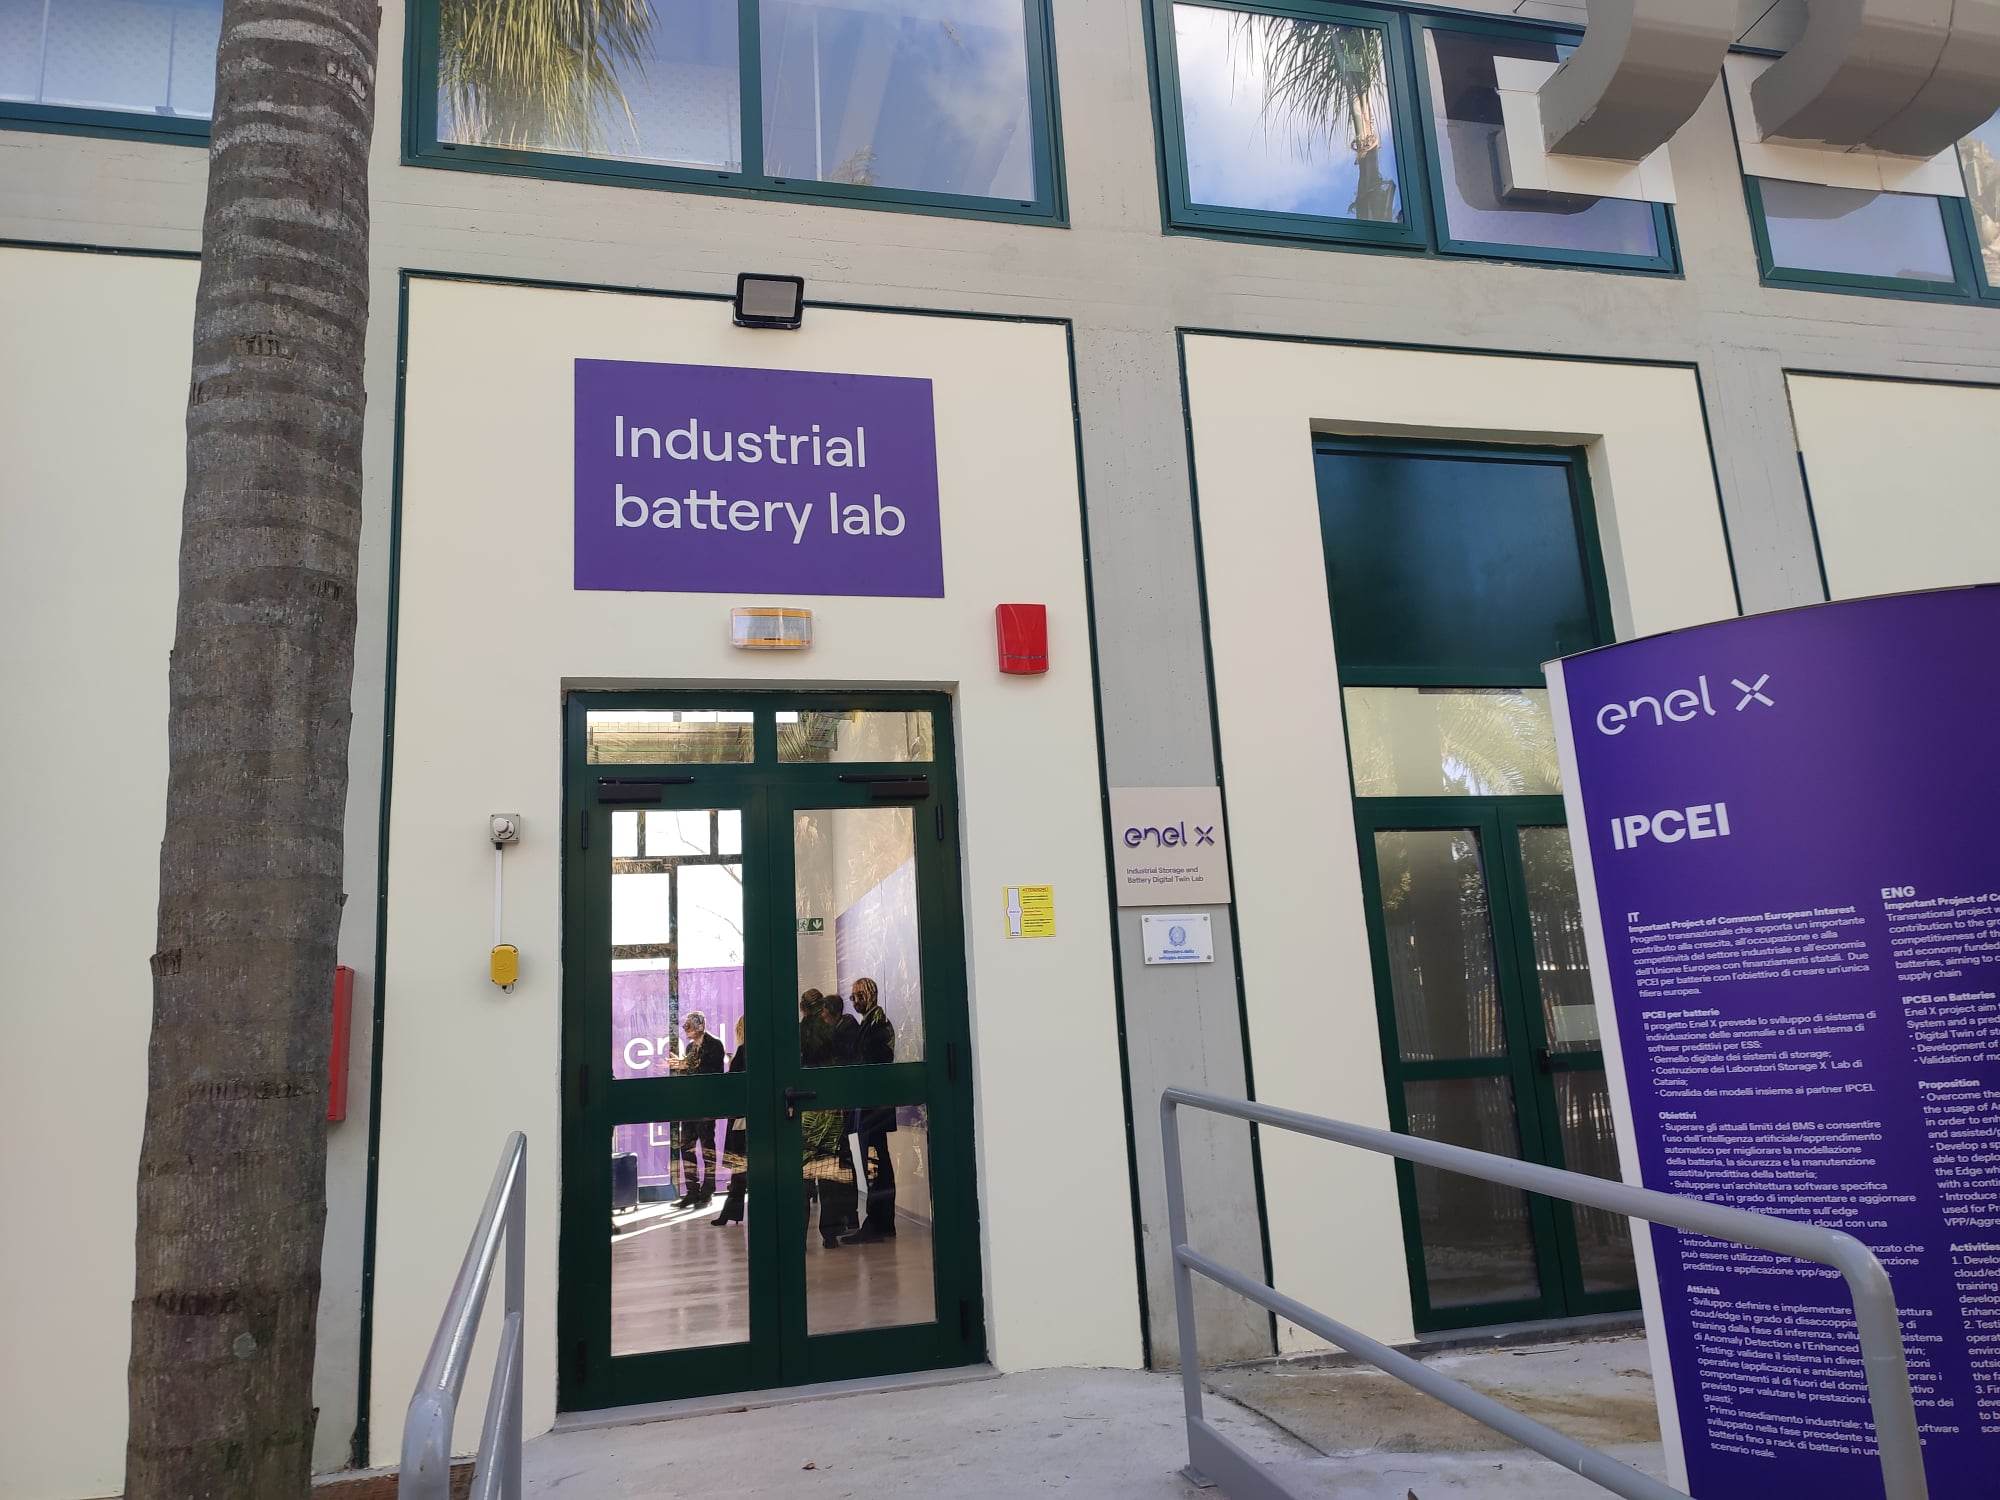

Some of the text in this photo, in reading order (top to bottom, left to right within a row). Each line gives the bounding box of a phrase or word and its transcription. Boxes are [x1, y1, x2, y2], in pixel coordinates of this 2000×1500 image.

[615, 415, 866, 468] Industrial
[615, 483, 906, 545] battery lab
[1596, 674, 1716, 736] enel
[1610, 802, 1731, 851] IPCEI
[1124, 821, 1187, 847] enel
[1126, 867, 1158, 875] Industrial
[1158, 867, 1185, 875] Storage
[1127, 876, 1152, 885] Battery
[1152, 876, 1174, 885] Digital
[1881, 886, 1915, 899] ENG
[1884, 894, 1988, 911] Important Project of
[1628, 912, 1640, 923] IT
[1887, 906, 1992, 921] Transnational project
[1629, 906, 1855, 934] Important Project of Common European Interest
[1889, 919, 1985, 933] contribution to the
[1631, 934, 1666, 944] Progetto
[1667, 928, 1733, 940] transnazionale
[1734, 926, 1753, 934] che
[1754, 923, 1792, 934] apporta
[1809, 917, 1865, 929] importante
[1891, 930, 1987, 946] competitiveness of
[1893, 947, 1913, 957] and
[1914, 945, 1962, 955] economy
[1895, 954, 1993, 969] batteries, aiming to
[1638, 978, 1659, 987] IPCEI
[1660, 979, 1674, 987] per
[1676, 975, 1711, 984] batterie
[1732, 970, 1779, 980] l'obiettivo
[1780, 969, 1791, 977] di
[1792, 968, 1825, 976] creare
[1897, 969, 1962, 982] supply chain
[1902, 995, 1932, 1004] IPCEI
[1948, 991, 1996, 1001] Batteries
[1642, 1009, 1720, 1020] IPCEI per batterie
[1904, 1003, 1997, 1016] Enel X project aim
[1650, 1021, 1688, 1032] progetto
[1689, 1020, 1709, 1028] Enel
[1710, 1020, 1717, 1028] X
[1718, 1018, 1757, 1029] prevede
[1758, 1017, 1768, 1025] lo
[1769, 1016, 1811, 1025] sviluppo
[1812, 1014, 1823, 1022] di
[1824, 1013, 1864, 1021] sistema
[1866, 1011, 1876, 1019] di
[1906, 1019, 1945, 1030] System
[1947, 1017, 1967, 1026] and
[1915, 1028, 1988, 1042] Digital Twin of
[1917, 1039, 1999, 1052] Development of
[1919, 1053, 1985, 1064] Validation of
[1918, 1079, 1980, 1090] Proposition
[1660, 1089, 1702, 1097] Convalida
[1702, 1088, 1717, 1096] dei
[1719, 1088, 1753, 1096] modelli
[1755, 1087, 1793, 1095] insieme
[1805, 1086, 1842, 1096] partner
[1926, 1090, 2000, 1101] Overcome the
[1923, 1103, 1989, 1114] the usage of
[1665, 1124, 1704, 1133] Superare
[1705, 1123, 1717, 1133] gli
[1718, 1123, 1747, 1131] attuali
[1792, 1122, 1815, 1130] BMS
[1825, 1121, 1881, 1130] consentire
[1925, 1118, 1935, 1126] in
[1937, 1117, 1965, 1125] order
[1968, 1116, 1980, 1124] to
[1928, 1129, 1948, 1138] and
[1664, 1146, 1861, 1156] automatico per migliorare la modellazione
[1935, 1142, 1979, 1151] Develop
[1726, 1158, 1735, 1166] la
[1791, 1158, 1800, 1166] la
[1801, 1158, 1876, 1166] manutenzione
[1932, 1155, 1955, 1163] able
[1957, 1154, 1970, 1162] to
[1935, 1167, 1983, 1177] the Edge
[1721, 1182, 1792, 1190] un'architettura
[1793, 1182, 1838, 1190] software
[1840, 1182, 1888, 1192] specifica
[1937, 1179, 1961, 1188] with
[1945, 1192, 1998, 1201] Introduce
[1942, 1204, 1986, 1213] used for
[1956, 1282, 1999, 1292] training
[1711, 1444, 1777, 1458] scenario reale.
